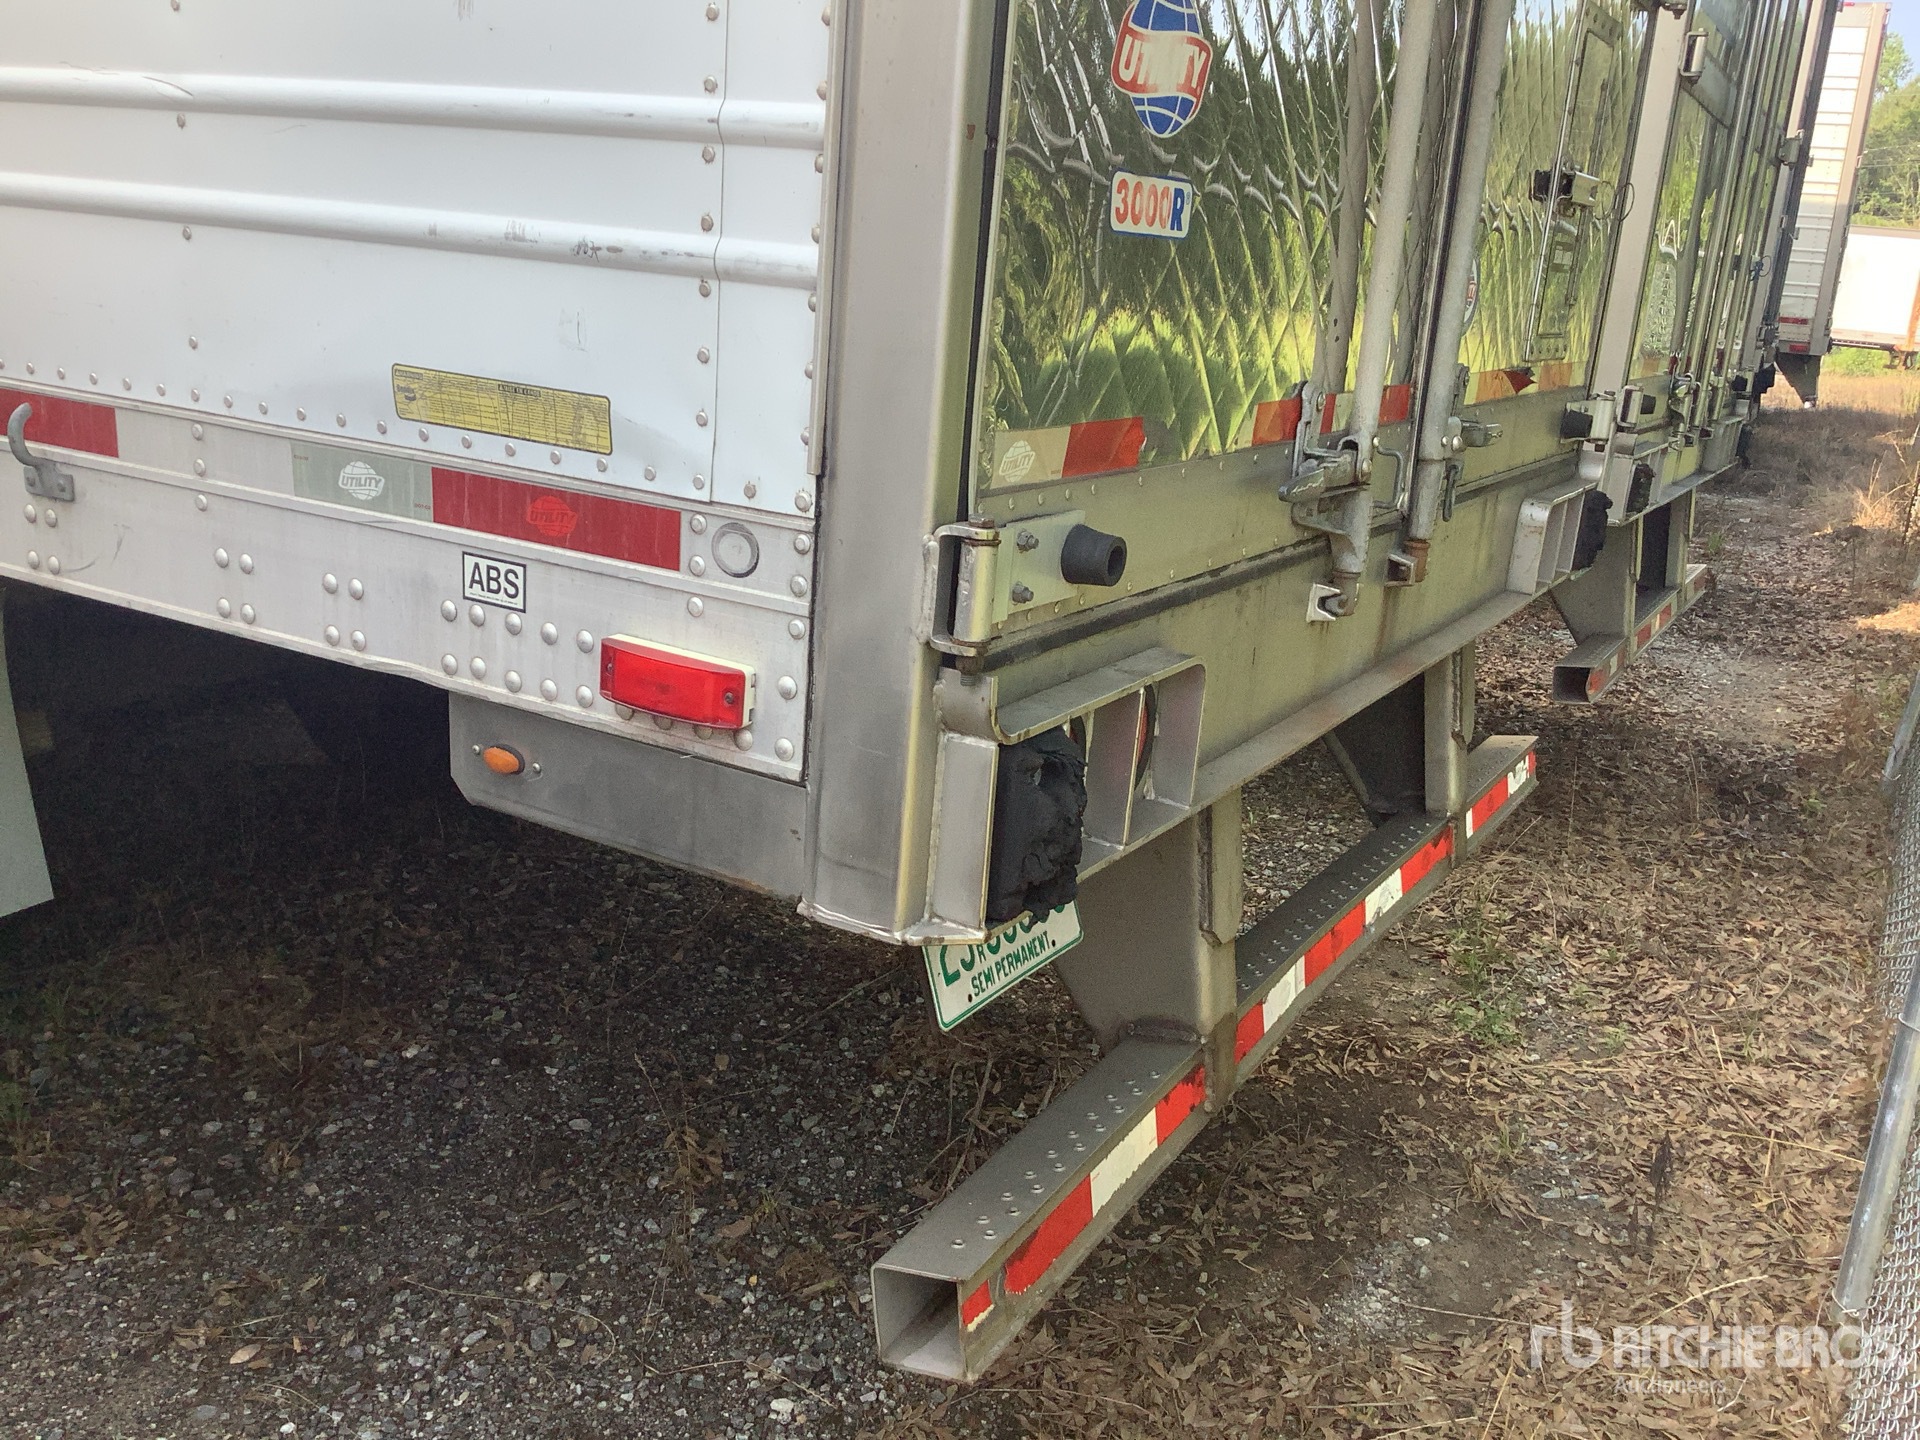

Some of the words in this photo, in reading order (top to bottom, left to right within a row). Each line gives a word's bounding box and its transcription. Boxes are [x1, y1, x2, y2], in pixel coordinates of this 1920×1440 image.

[1118, 34, 1207, 89] UTTY
[341, 476, 383, 489] UTILITY
[530, 509, 576, 524] UTILITY
[469, 562, 519, 599] ABS
[971, 966, 996, 997] SEMI
[995, 930, 1051, 982] PERMANENT
